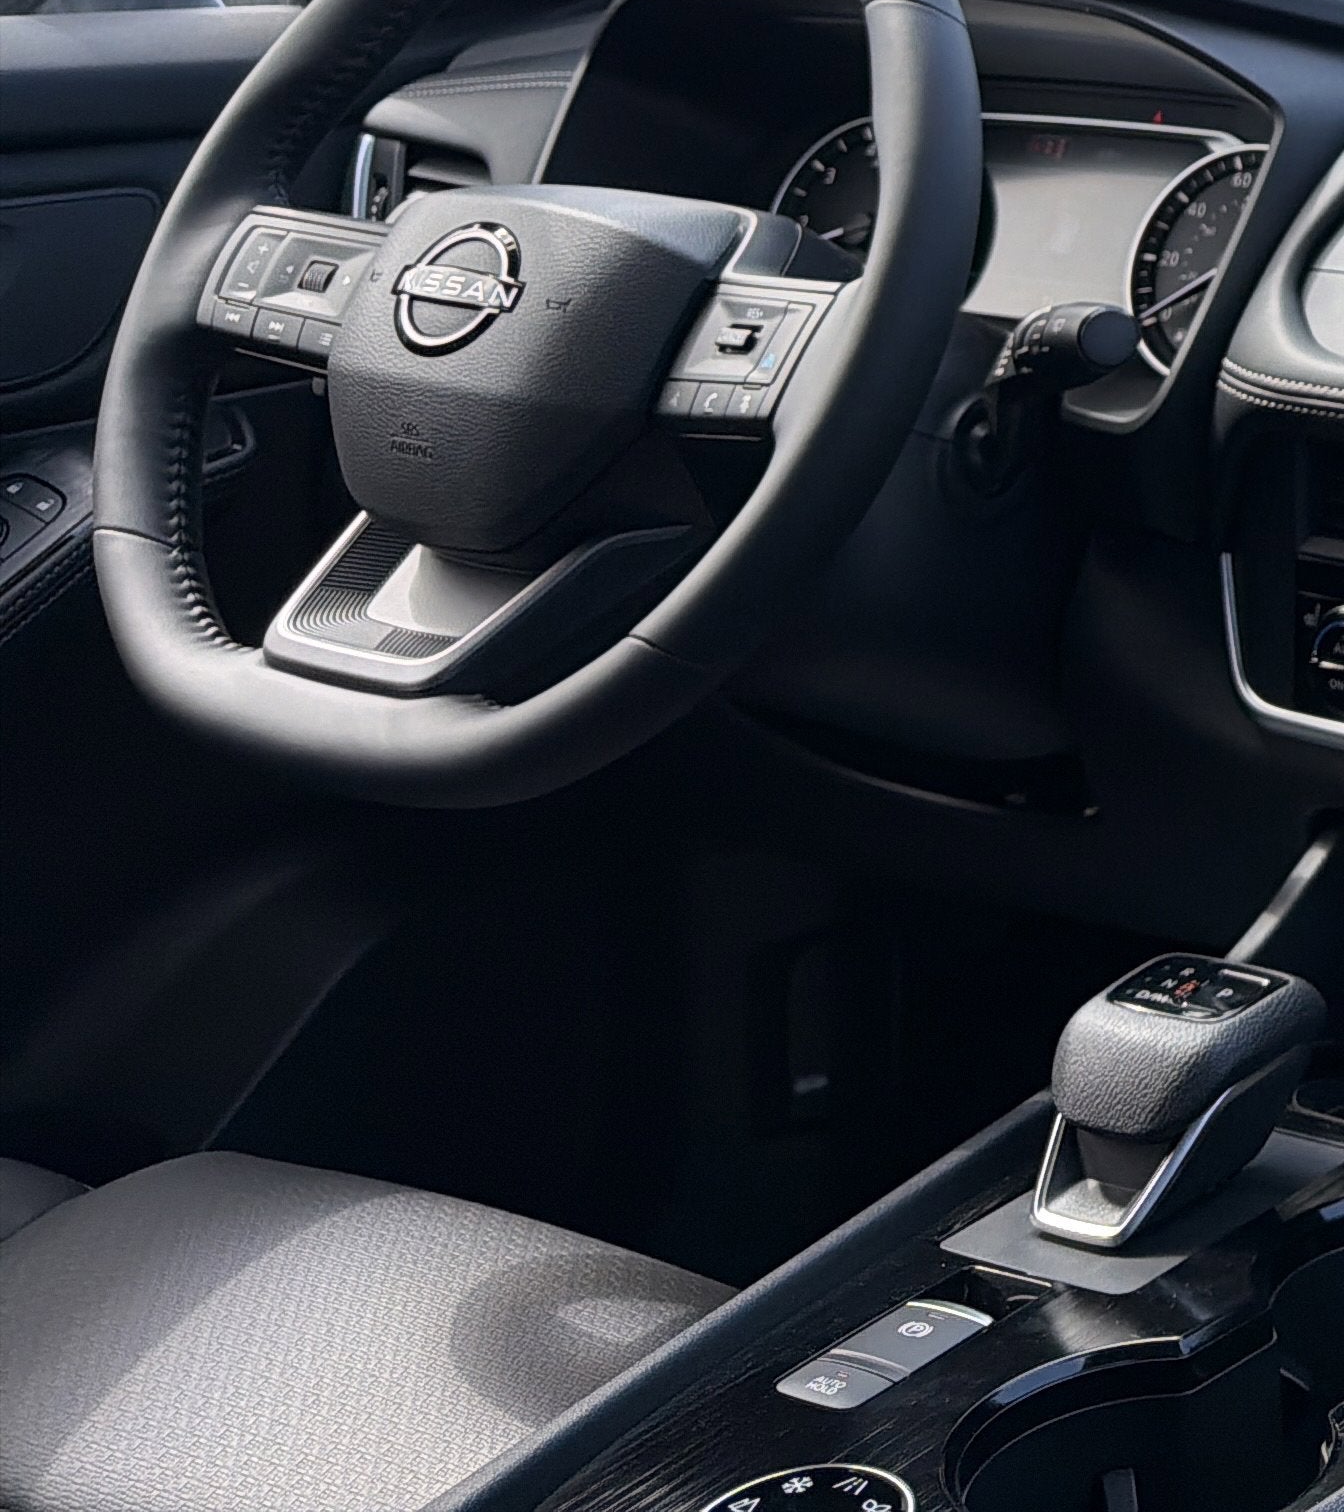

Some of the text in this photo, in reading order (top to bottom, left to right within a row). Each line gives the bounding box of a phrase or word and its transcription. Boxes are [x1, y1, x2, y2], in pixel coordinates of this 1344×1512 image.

[1231, 172, 1252, 188] 60
[1187, 202, 1207, 218] 40
[1160, 251, 1180, 267] 20
[397, 270, 519, 308] NISSAN
[1180, 967, 1196, 977] R
[1160, 979, 1178, 988] N
[1216, 988, 1234, 998] P
[805, 1381, 839, 1396] HOLD
[815, 1375, 847, 1389] AUTO
